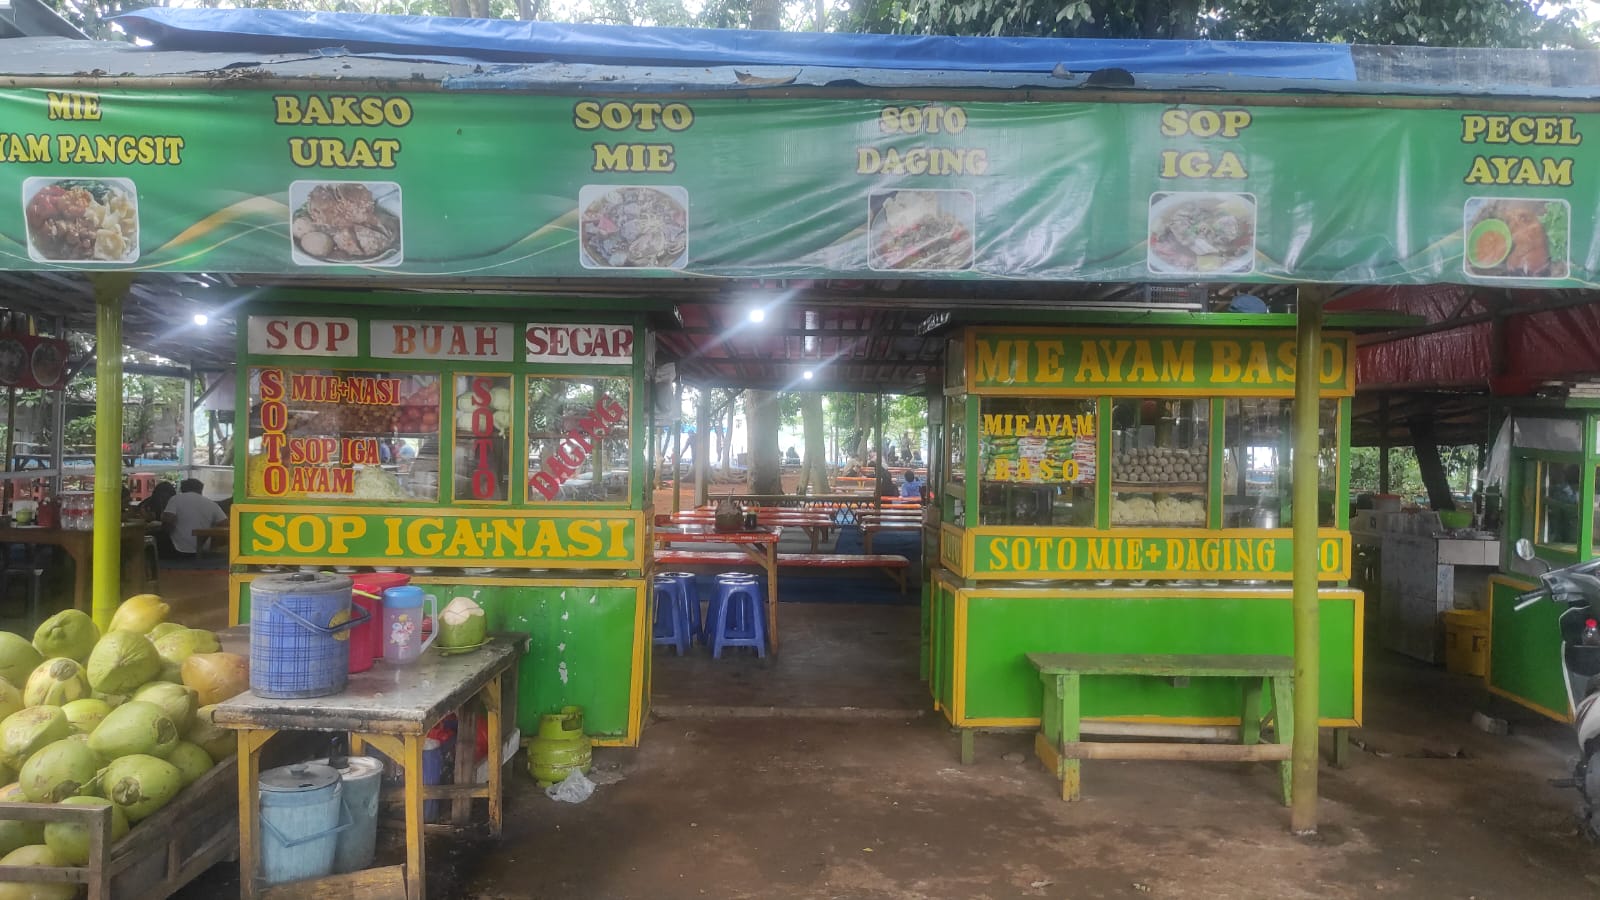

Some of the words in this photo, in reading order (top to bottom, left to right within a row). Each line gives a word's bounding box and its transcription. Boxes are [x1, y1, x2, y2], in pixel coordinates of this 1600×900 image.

[48, 92, 102, 121] MIE
[274, 95, 413, 127] BAKSO
[574, 101, 694, 132] SOTO
[878, 105, 968, 136] SOTO
[1160, 109, 1253, 138] SOP
[1462, 114, 1583, 146] PECEL
[57, 135, 184, 165] PANGSIT
[290, 137, 401, 168] URAT
[592, 143, 676, 173] MIE
[857, 146, 989, 175] DAGING
[1160, 150, 1248, 179] IGA
[1465, 156, 1574, 186] AYAM
[266, 320, 350, 351] SOP
[392, 325, 499, 356] BUAH
[525, 326, 634, 358] SEGAR
[975, 337, 1065, 384] MIE
[1074, 339, 1197, 384] AYAM
[1210, 340, 1344, 384] BASO
[291, 374, 401, 406] MIE+NASI
[260, 369, 289, 496] SOTO
[472, 377, 495, 499] SOTO
[984, 414, 1029, 436] MIE
[1034, 414, 1093, 436] AYAM
[290, 437, 337, 465] SOP
[340, 438, 380, 466] IGA
[528, 394, 624, 501] DAGING
[291, 468, 355, 494] AYAM
[994, 458, 1079, 480] BASO
[252, 515, 366, 554] SOP
[384, 518, 628, 556] IGA+NASI
[989, 537, 1077, 571] SOTO
